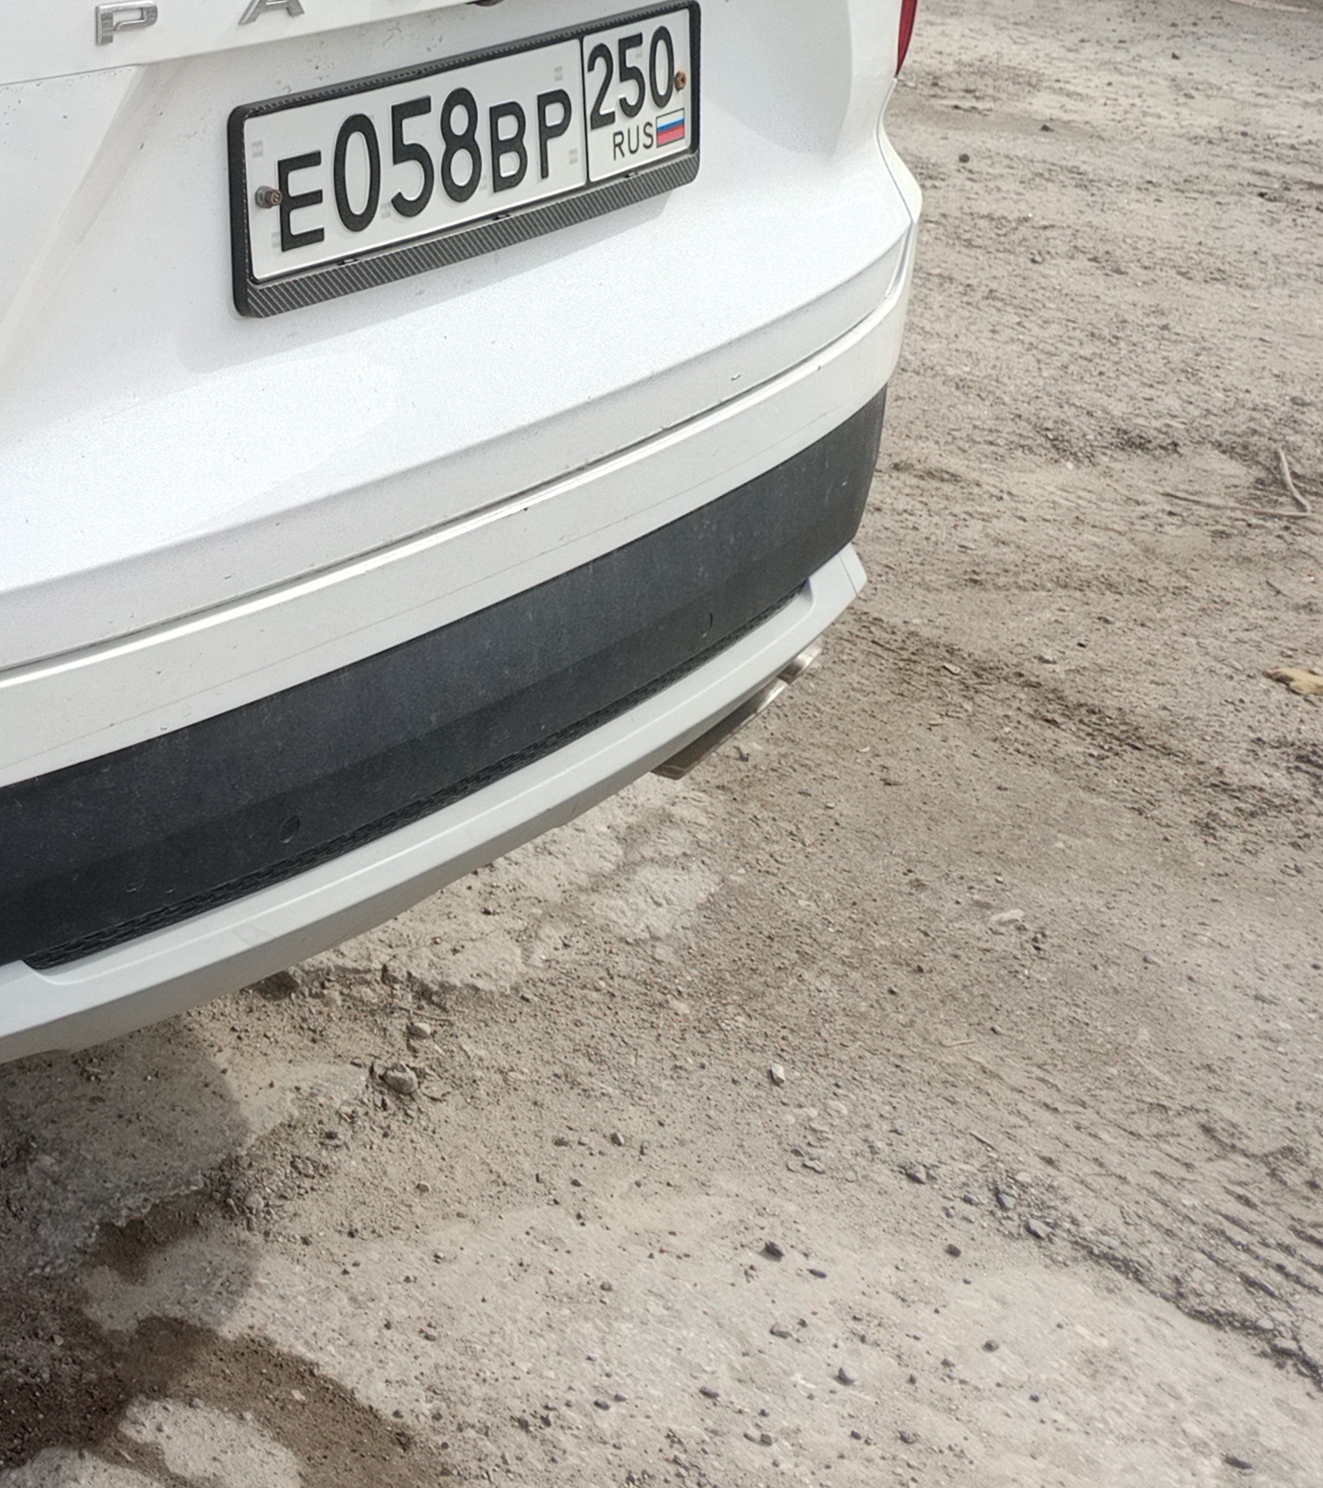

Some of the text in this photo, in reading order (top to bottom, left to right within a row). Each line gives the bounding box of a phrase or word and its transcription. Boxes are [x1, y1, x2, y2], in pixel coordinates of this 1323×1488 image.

[277, 25, 674, 252] Е058ВР 250
[612, 121, 654, 161] RUS
